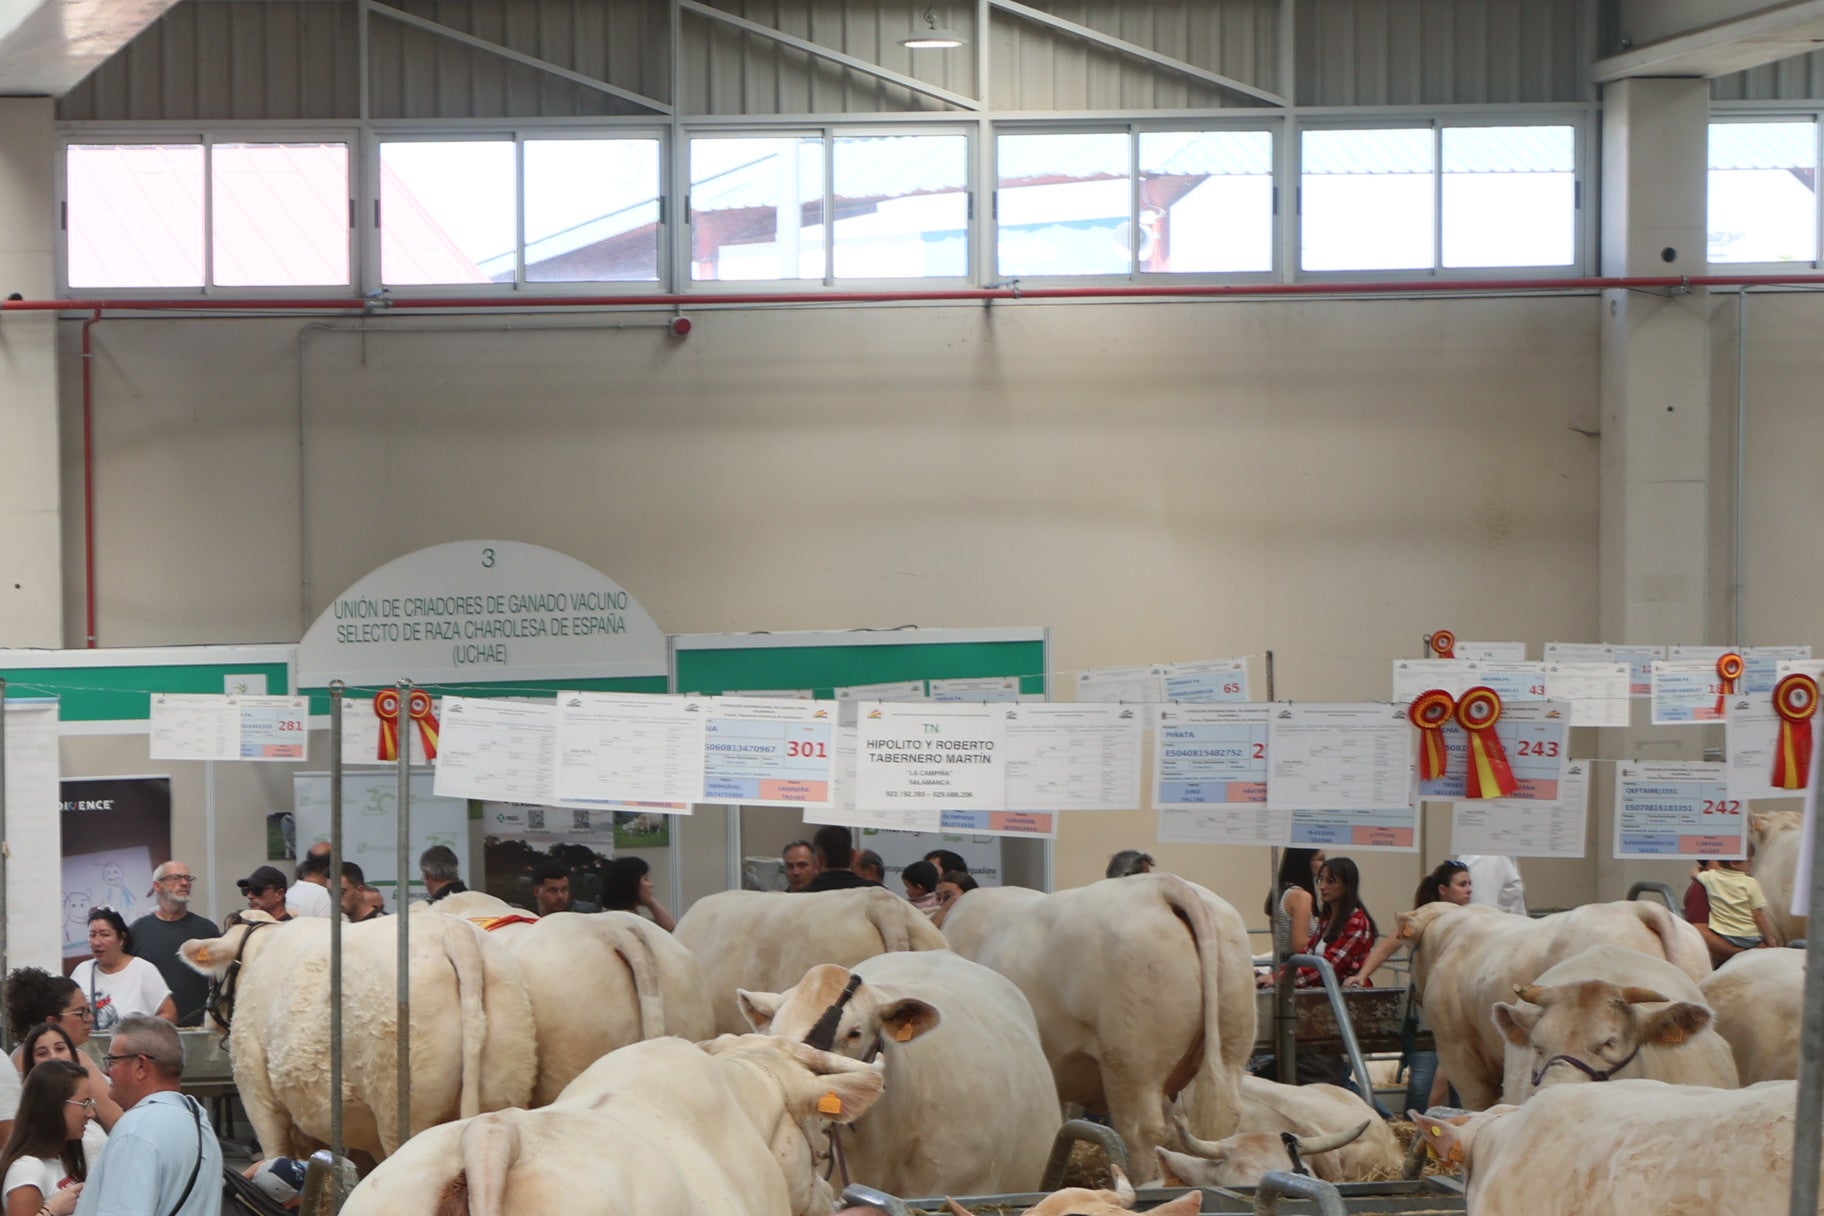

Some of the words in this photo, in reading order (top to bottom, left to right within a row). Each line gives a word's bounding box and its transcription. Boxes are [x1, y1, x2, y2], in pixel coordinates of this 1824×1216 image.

[481, 548, 496, 568] 3
[334, 595, 378, 619] UNIÓN
[382, 598, 400, 617] DE
[404, 595, 483, 617] CRIADORES
[487, 594, 504, 615] DE
[509, 592, 566, 614] GANADO
[571, 590, 627, 611] VACUNO
[337, 622, 398, 643] SELECTO
[403, 621, 421, 641] DE
[424, 620, 461, 640] RAZA
[464, 618, 546, 639] CHAROLESA
[551, 617, 567, 637] DE
[572, 612, 626, 636] ESPAÑA
[453, 643, 507, 666] (UCHAE)
[1223, 682, 1241, 695] 65
[1528, 684, 1545, 696] 43
[278, 720, 303, 732] 281
[922, 722, 939, 734] TN
[786, 741, 828, 759] 301
[866, 739, 922, 751] HIPOLITO
[924, 740, 932, 750] Y
[936, 740, 994, 751] ROBERTO
[1517, 740, 1560, 757] 243
[869, 753, 943, 764] TABERNERO
[946, 752, 992, 764] MARTÍN
[1702, 799, 1740, 815] 242
